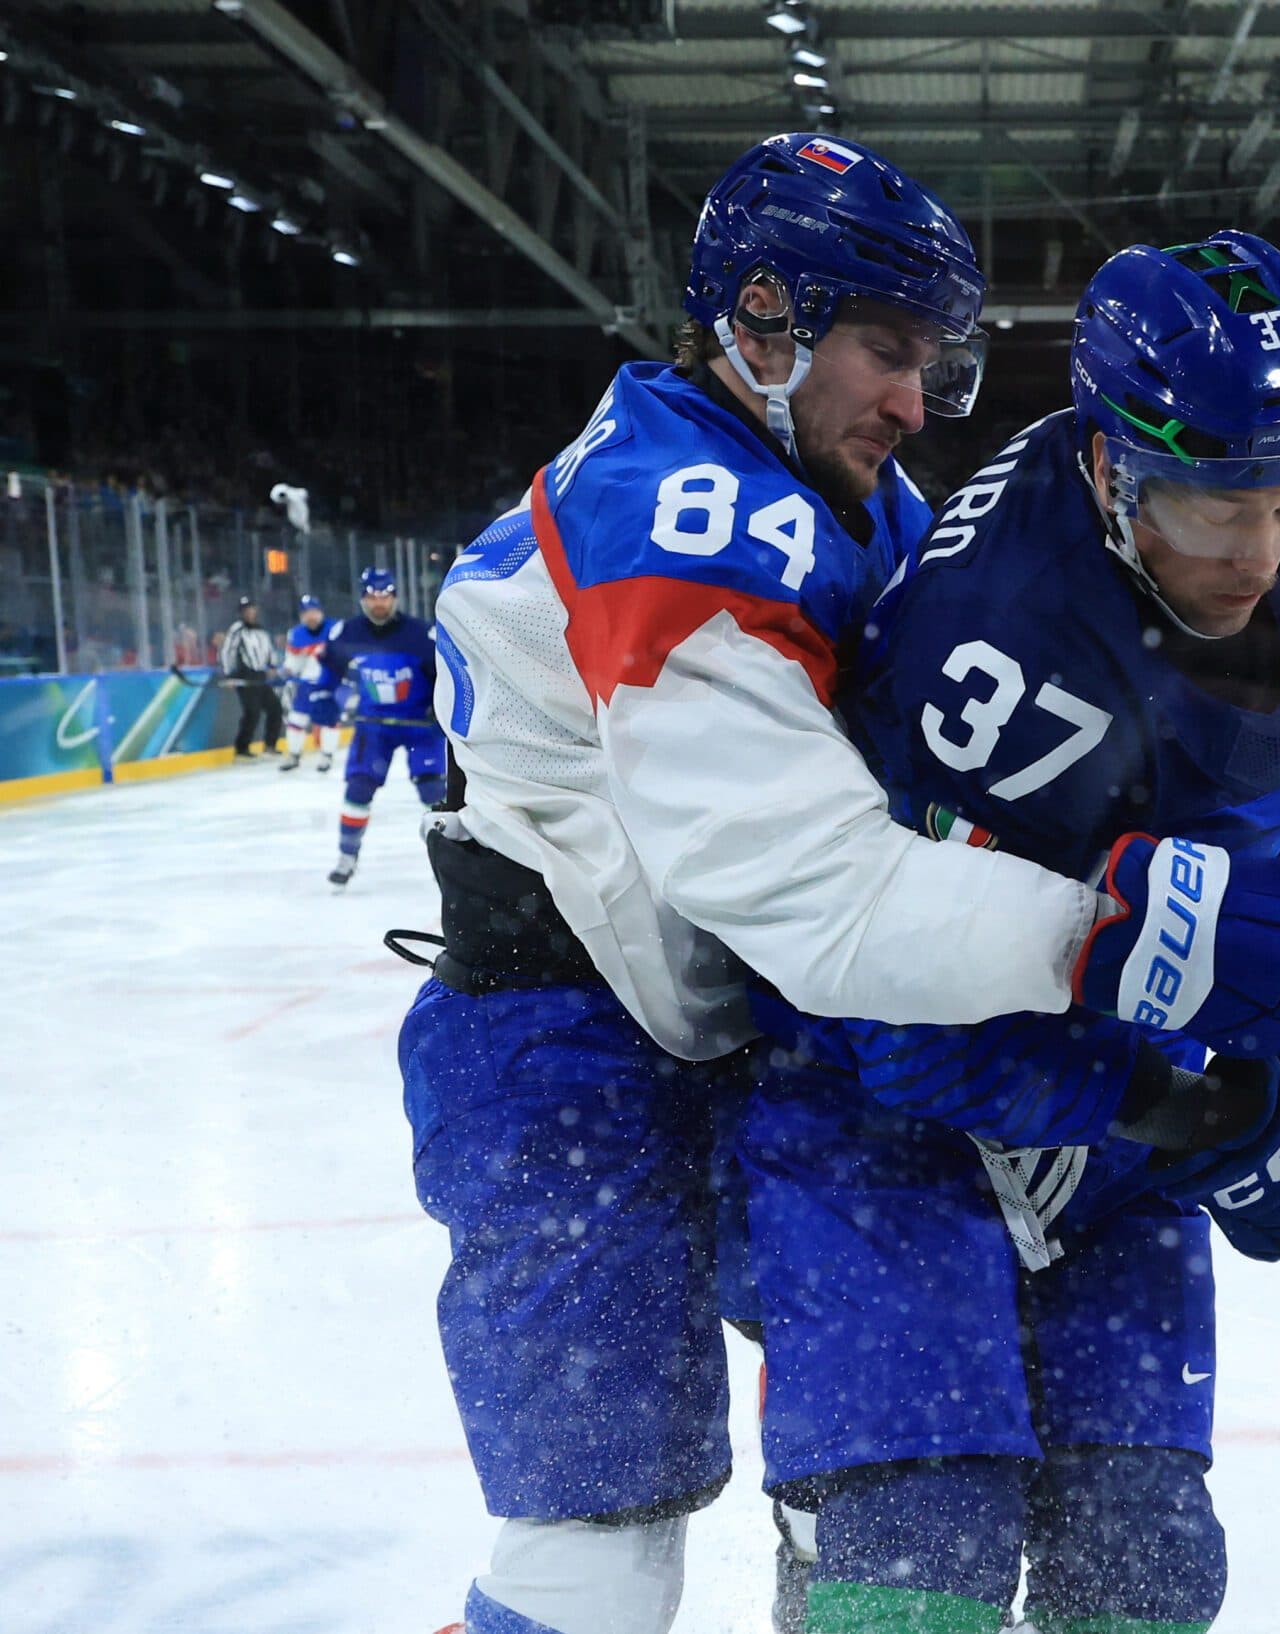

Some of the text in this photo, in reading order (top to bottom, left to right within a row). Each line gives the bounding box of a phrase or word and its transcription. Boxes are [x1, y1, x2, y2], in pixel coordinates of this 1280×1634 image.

[1075, 357, 1097, 395] CCM
[650, 463, 815, 591] 84
[921, 639, 1114, 801] 37
